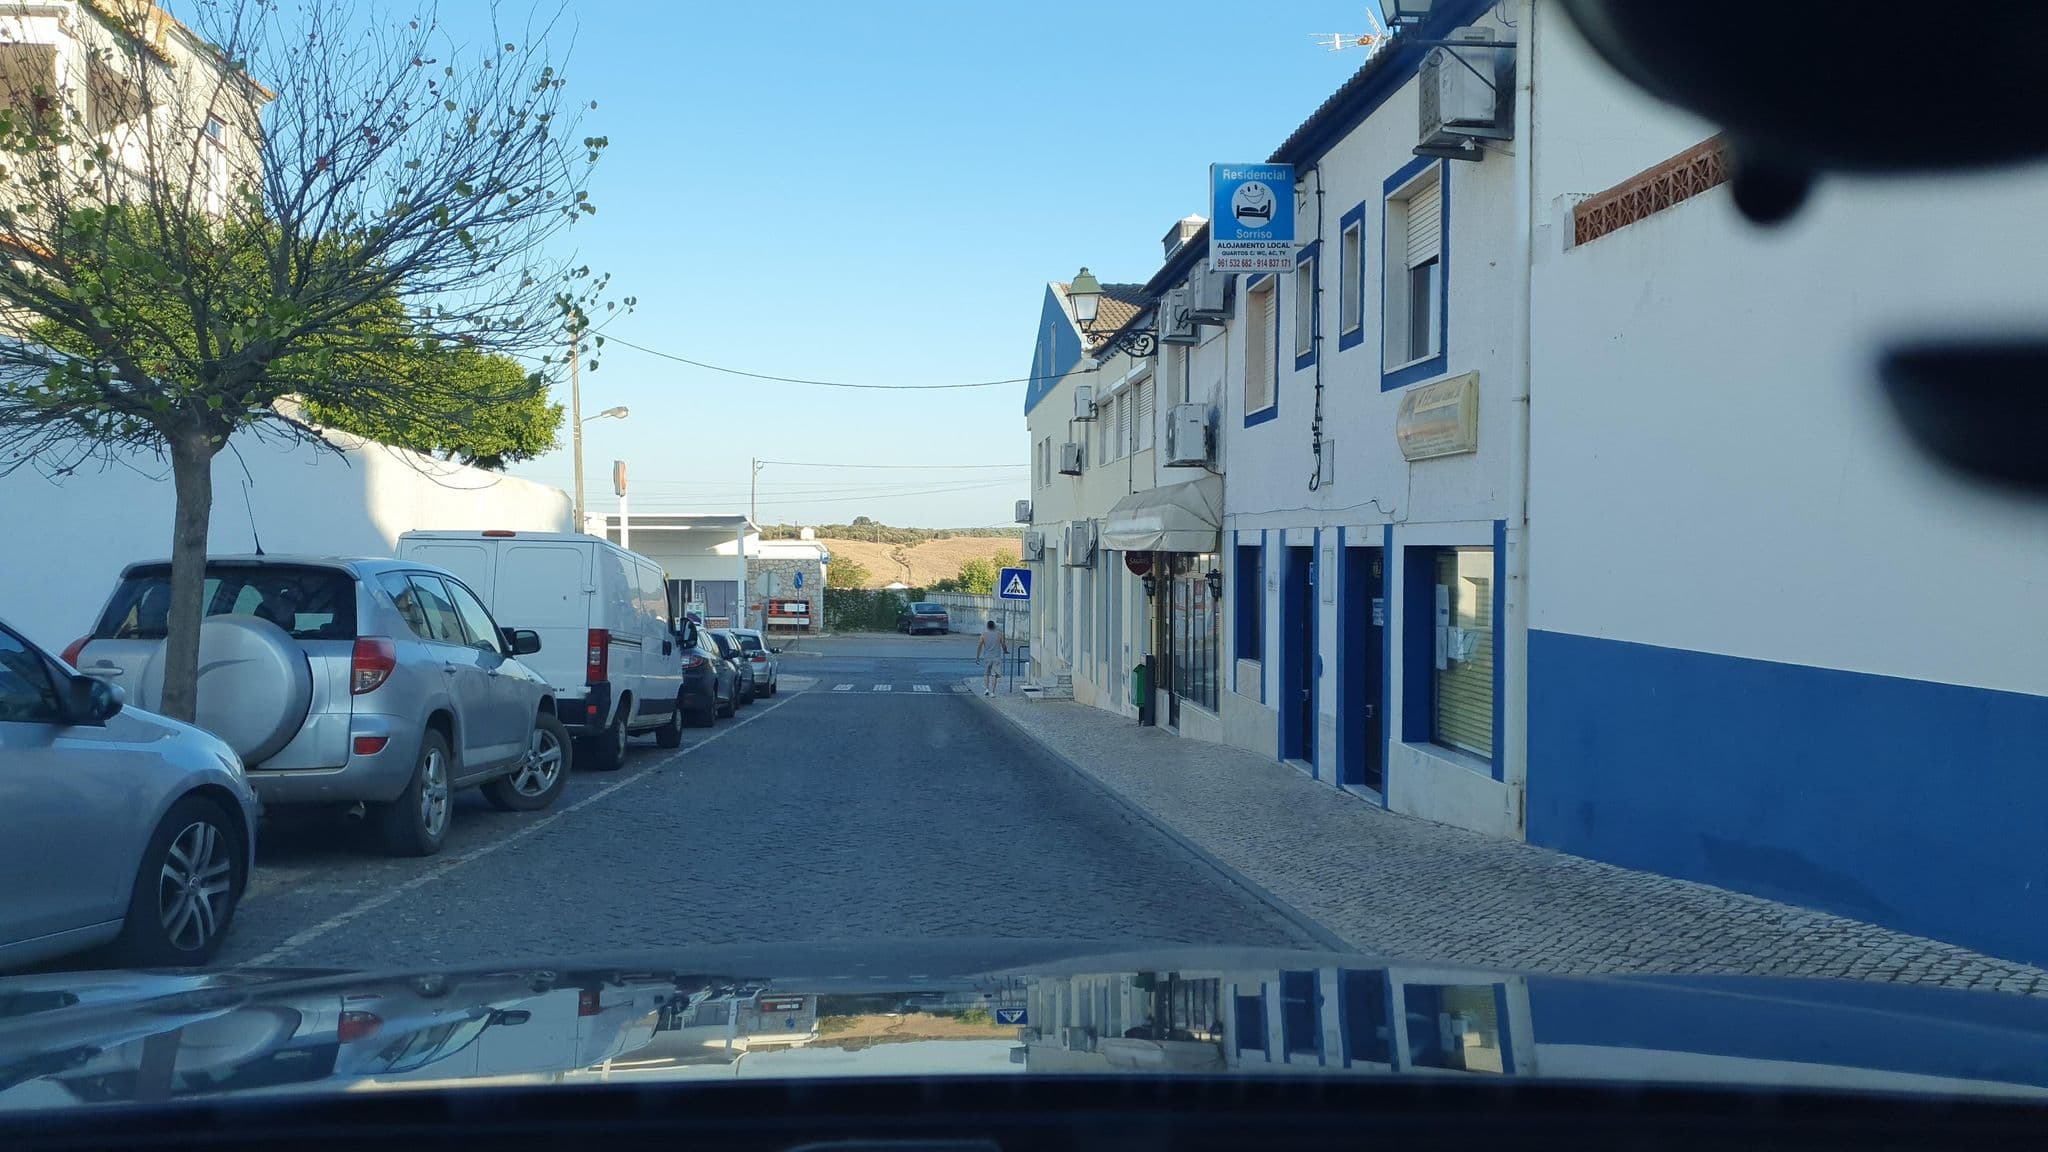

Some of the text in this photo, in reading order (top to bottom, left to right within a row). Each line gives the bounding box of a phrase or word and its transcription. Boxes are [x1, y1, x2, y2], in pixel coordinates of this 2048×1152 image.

[1223, 169, 1286, 180] Residencial
[1236, 229, 1272, 239] Sorriso
[1256, 259, 1267, 267] 914
[1281, 259, 1291, 267] 171
